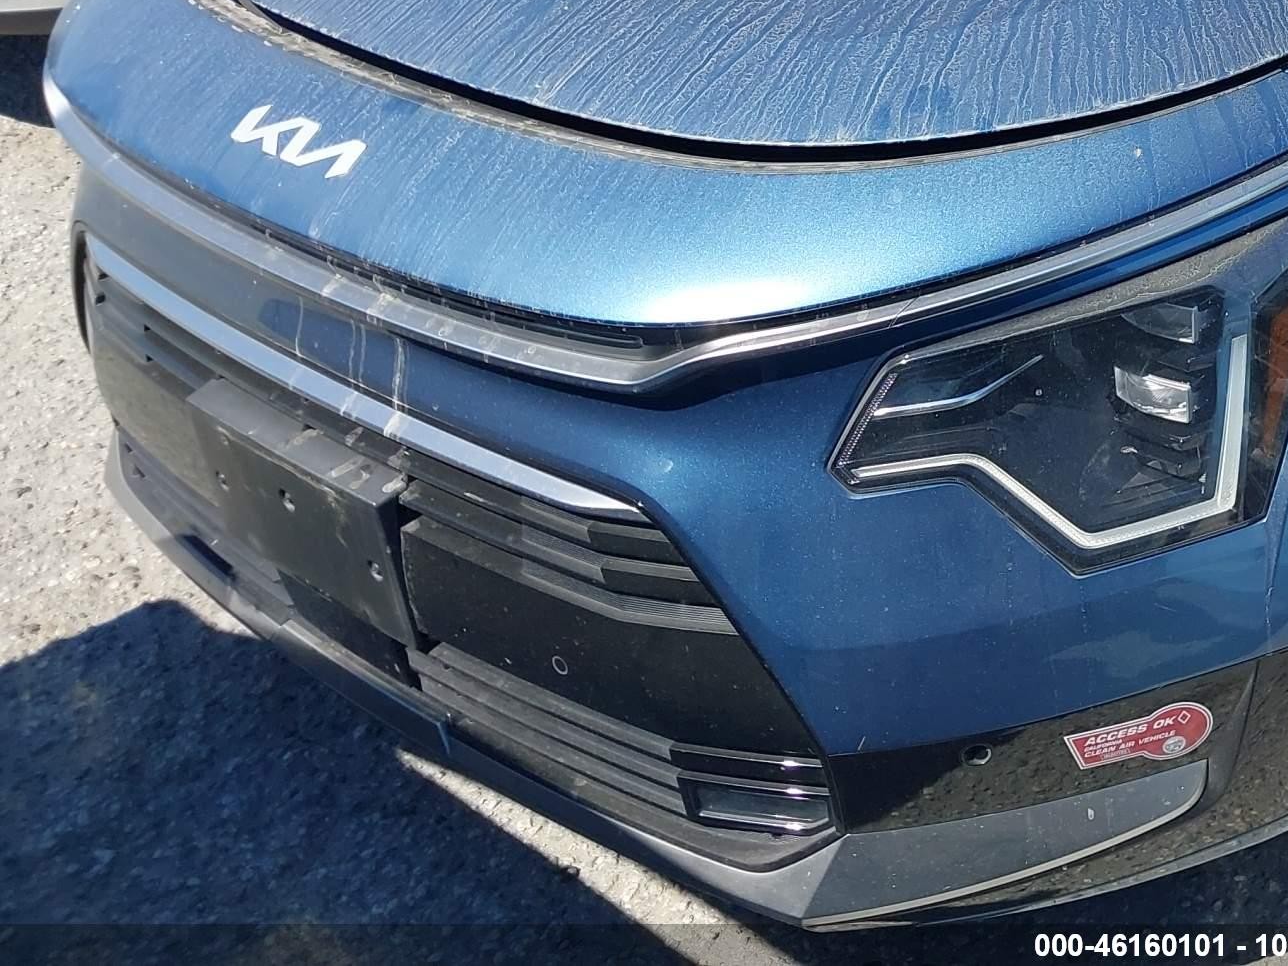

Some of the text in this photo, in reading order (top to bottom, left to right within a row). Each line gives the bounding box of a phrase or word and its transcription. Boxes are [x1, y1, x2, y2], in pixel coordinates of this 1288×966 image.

[230, 104, 368, 179] KIA
[1084, 716, 1177, 746] ACCESS OK
[1084, 745, 1117, 758] CLEAN
[1119, 740, 1136, 750] AIR
[1138, 729, 1177, 745] VEHICLE
